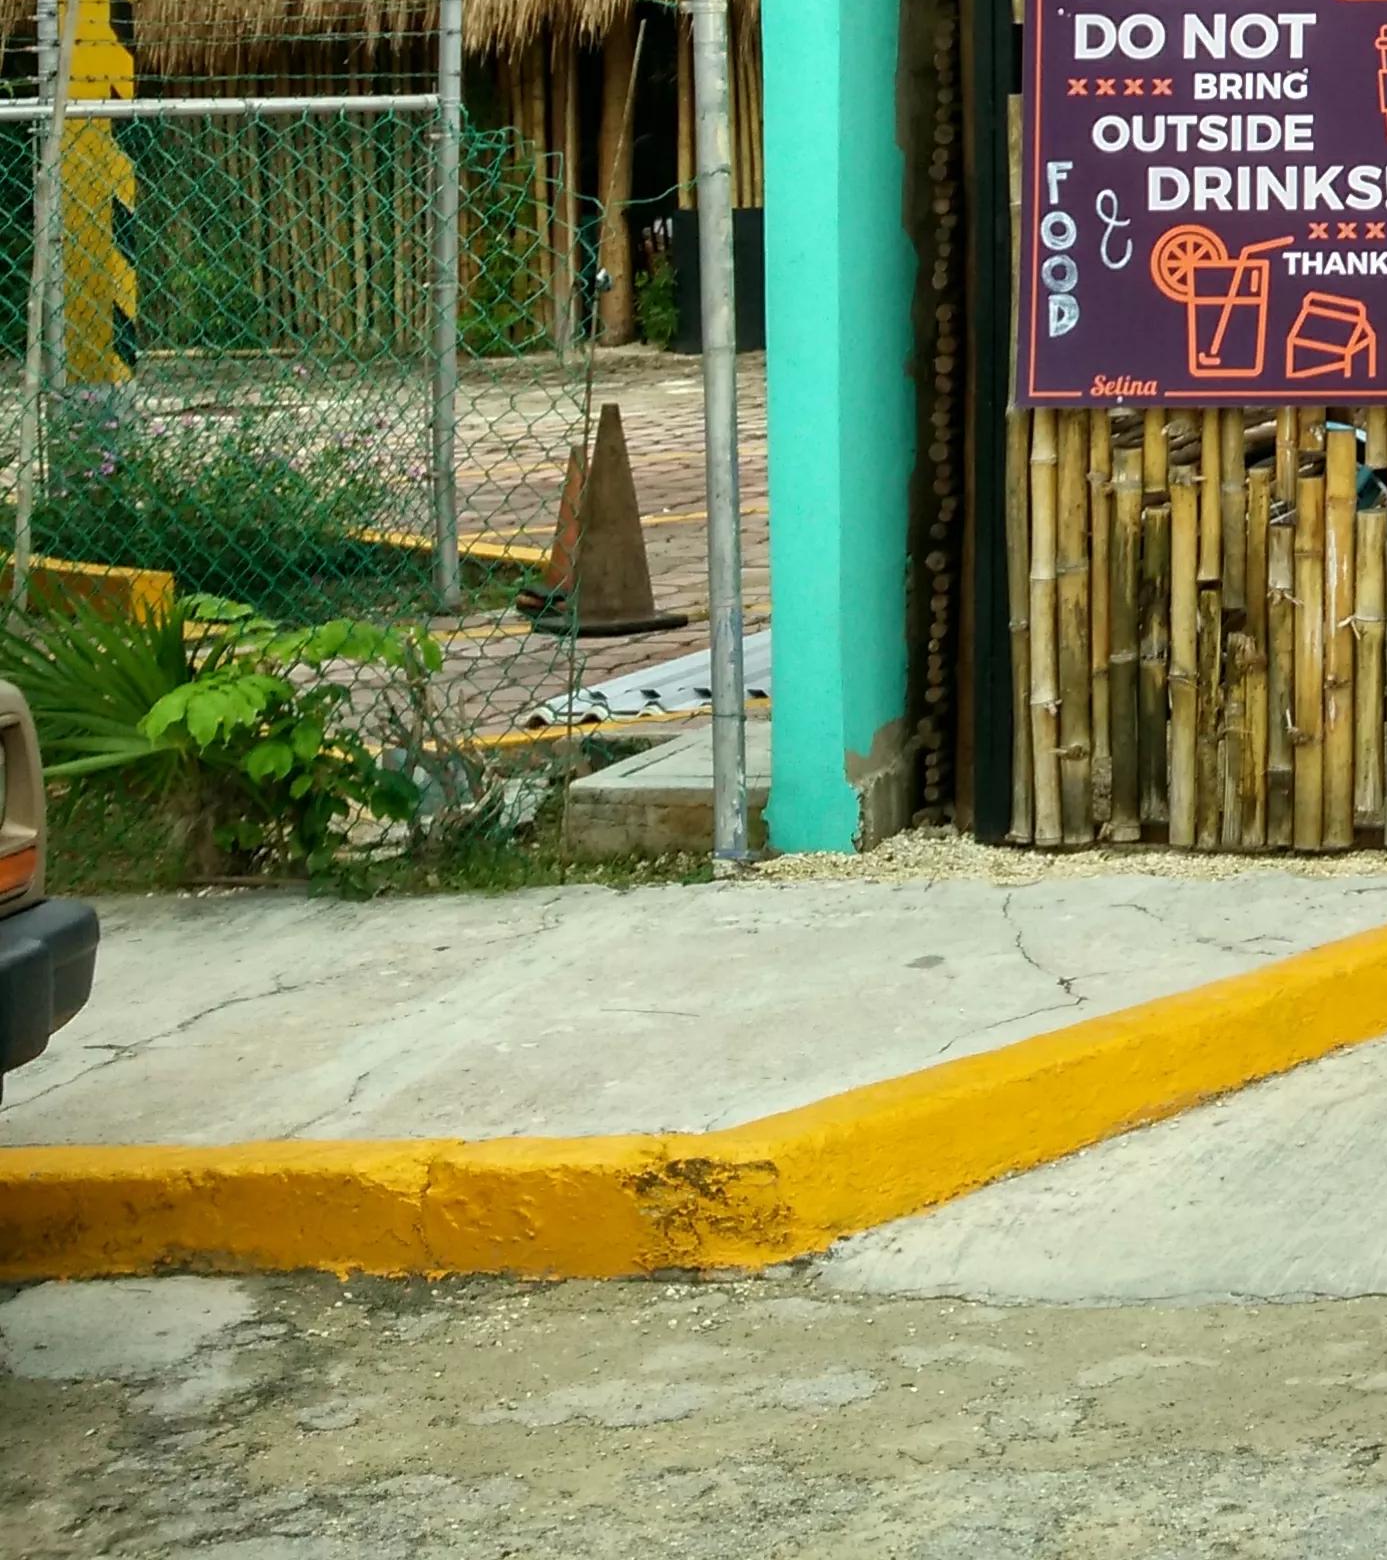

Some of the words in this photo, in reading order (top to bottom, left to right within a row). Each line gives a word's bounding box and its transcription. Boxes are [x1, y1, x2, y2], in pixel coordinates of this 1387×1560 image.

[1073, 13, 1166, 60] DO
[1183, 13, 1317, 60] NOT
[1193, 72, 1309, 100] BRING
[1092, 114, 1314, 153] OUTSIDE
[1041, 161, 1080, 338] FOOD
[1089, 374, 1159, 397] Selina
